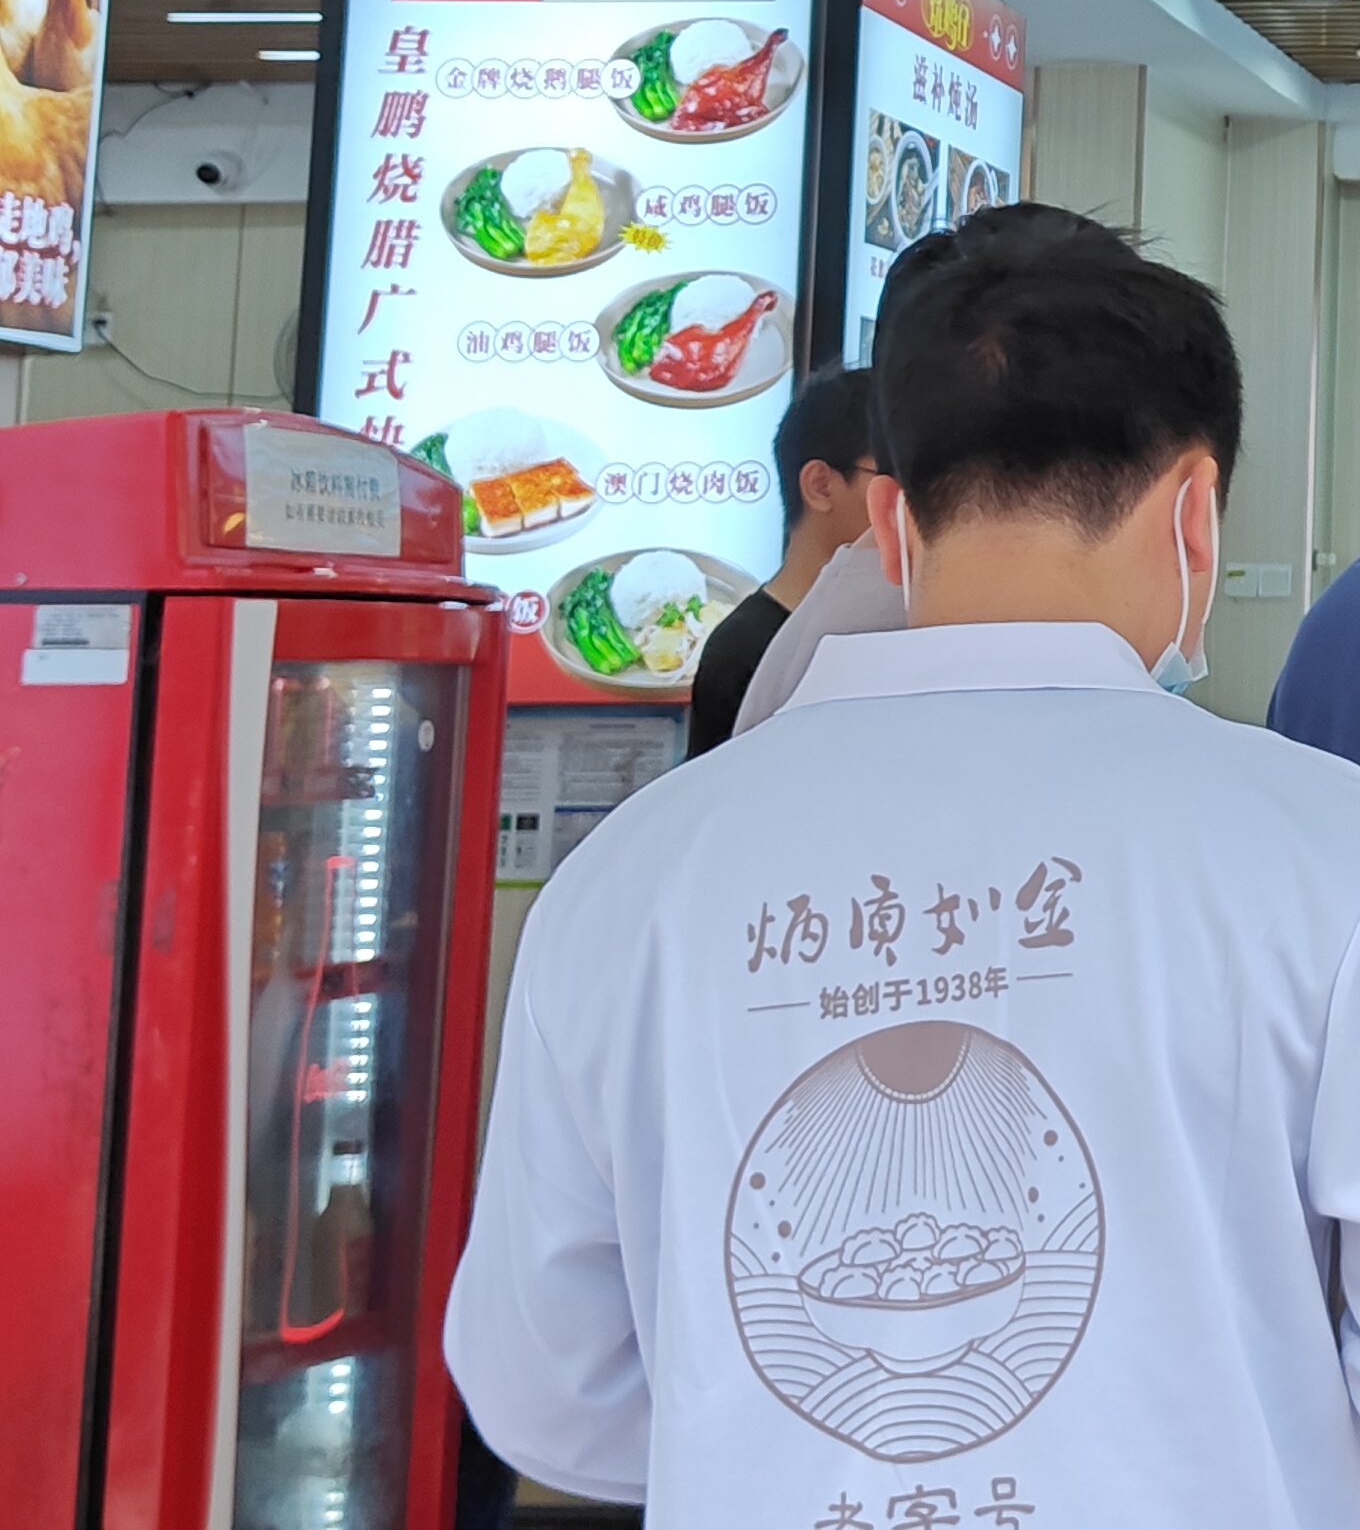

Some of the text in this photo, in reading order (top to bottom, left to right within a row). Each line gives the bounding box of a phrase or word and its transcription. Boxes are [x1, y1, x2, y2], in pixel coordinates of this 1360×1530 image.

[443, 65, 637, 91] 金牌烧鹅腿饭
[911, 53, 979, 131] 滋补炖汤
[643, 197, 771, 220] 咸鸡腿饭
[466, 328, 592, 356] 油鸡腿饭
[603, 468, 761, 496] 澳门烧肉饭
[819, 965, 1010, 1020] 始创于1938年
